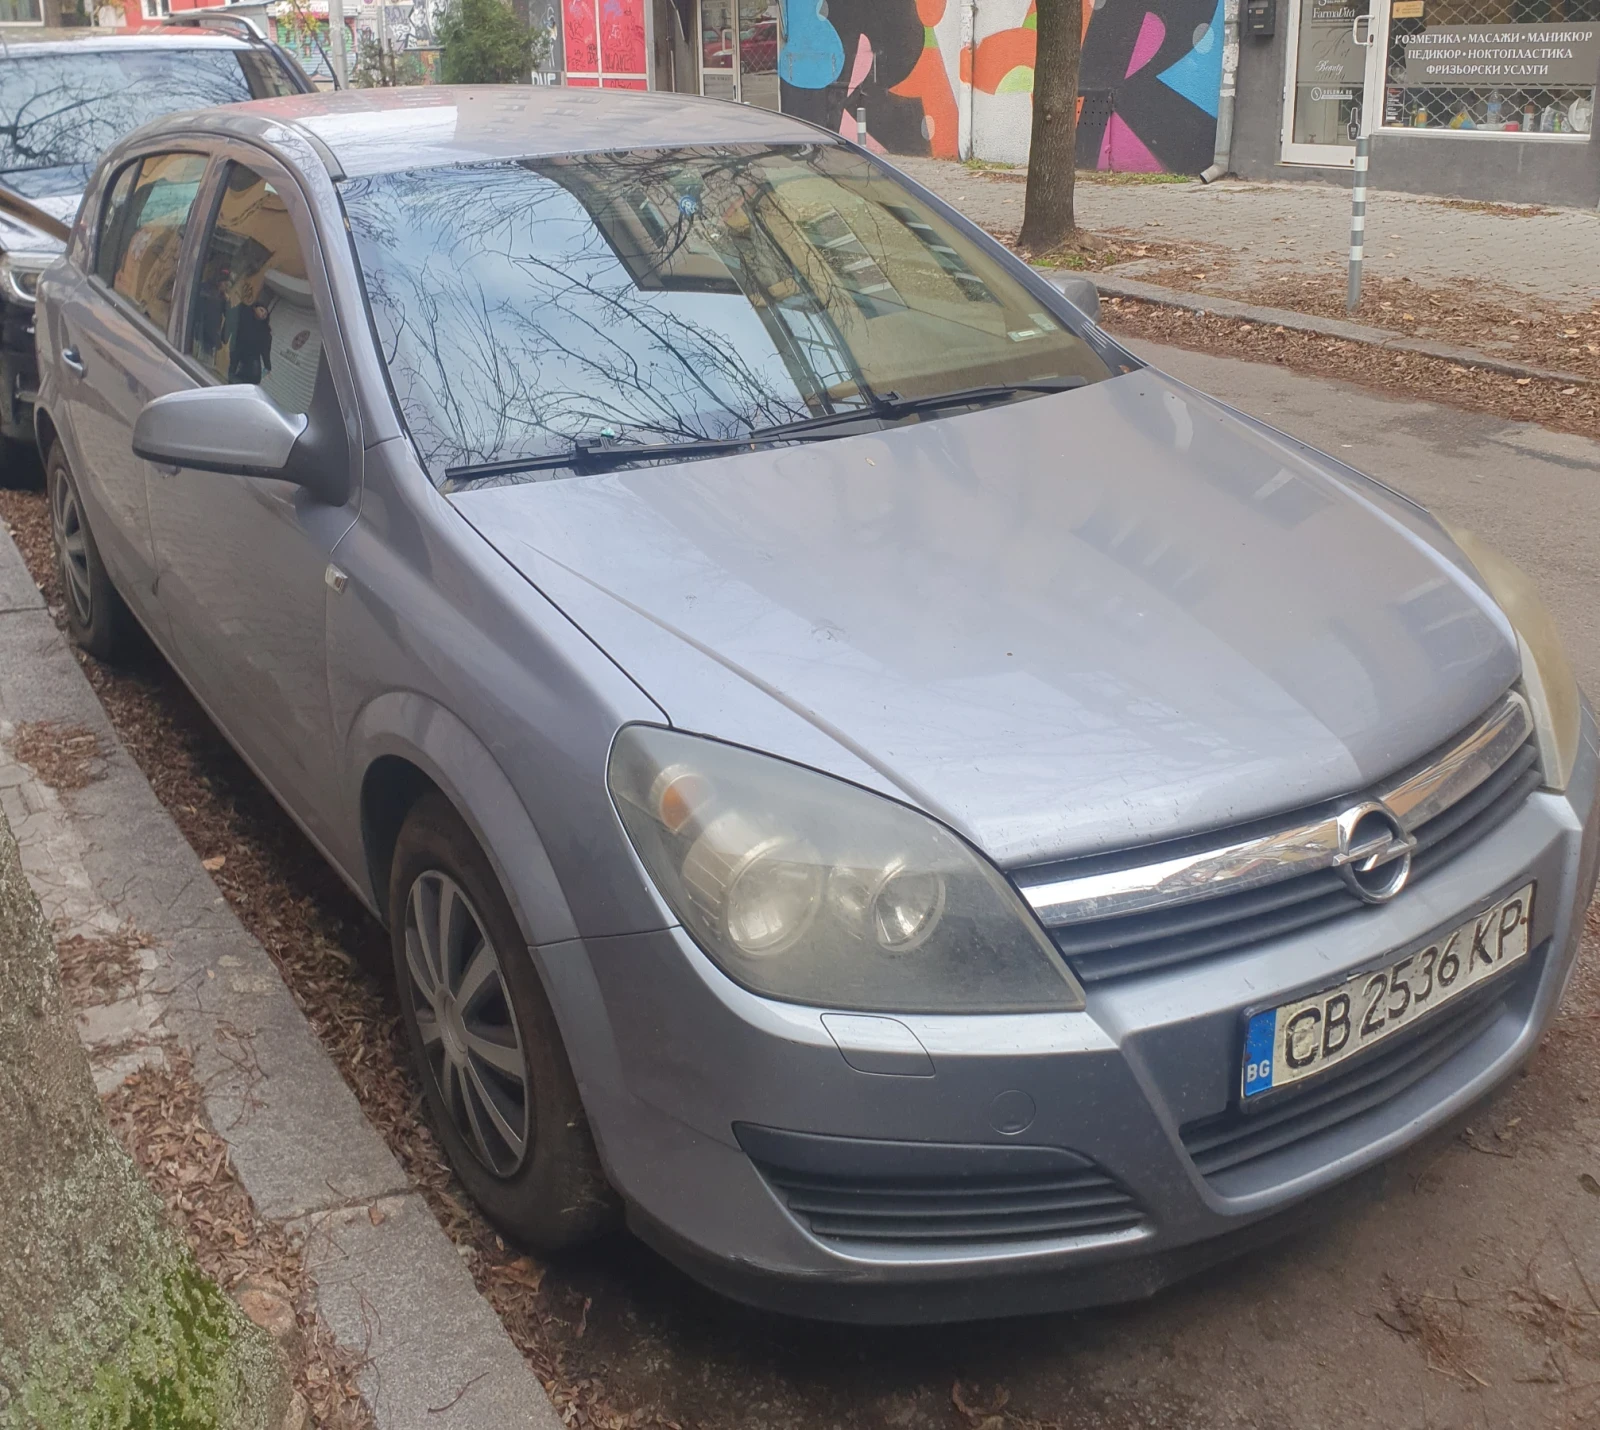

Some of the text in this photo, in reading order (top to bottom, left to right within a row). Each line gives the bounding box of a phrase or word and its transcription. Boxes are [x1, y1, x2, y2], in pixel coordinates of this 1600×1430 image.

[1468, 33, 1520, 43] МАСАЖИ
[1527, 31, 1593, 42] МАНИКЮР
[1408, 48, 1573, 60] ПЕДИКЮР НОКТОПЛАСТИКА
[1426, 64, 1549, 75] ФРИЗЬОРСКИ УСЛУГИ
[1284, 898, 1523, 1069] CB 2536 KP
[1246, 1059, 1270, 1083] BG
